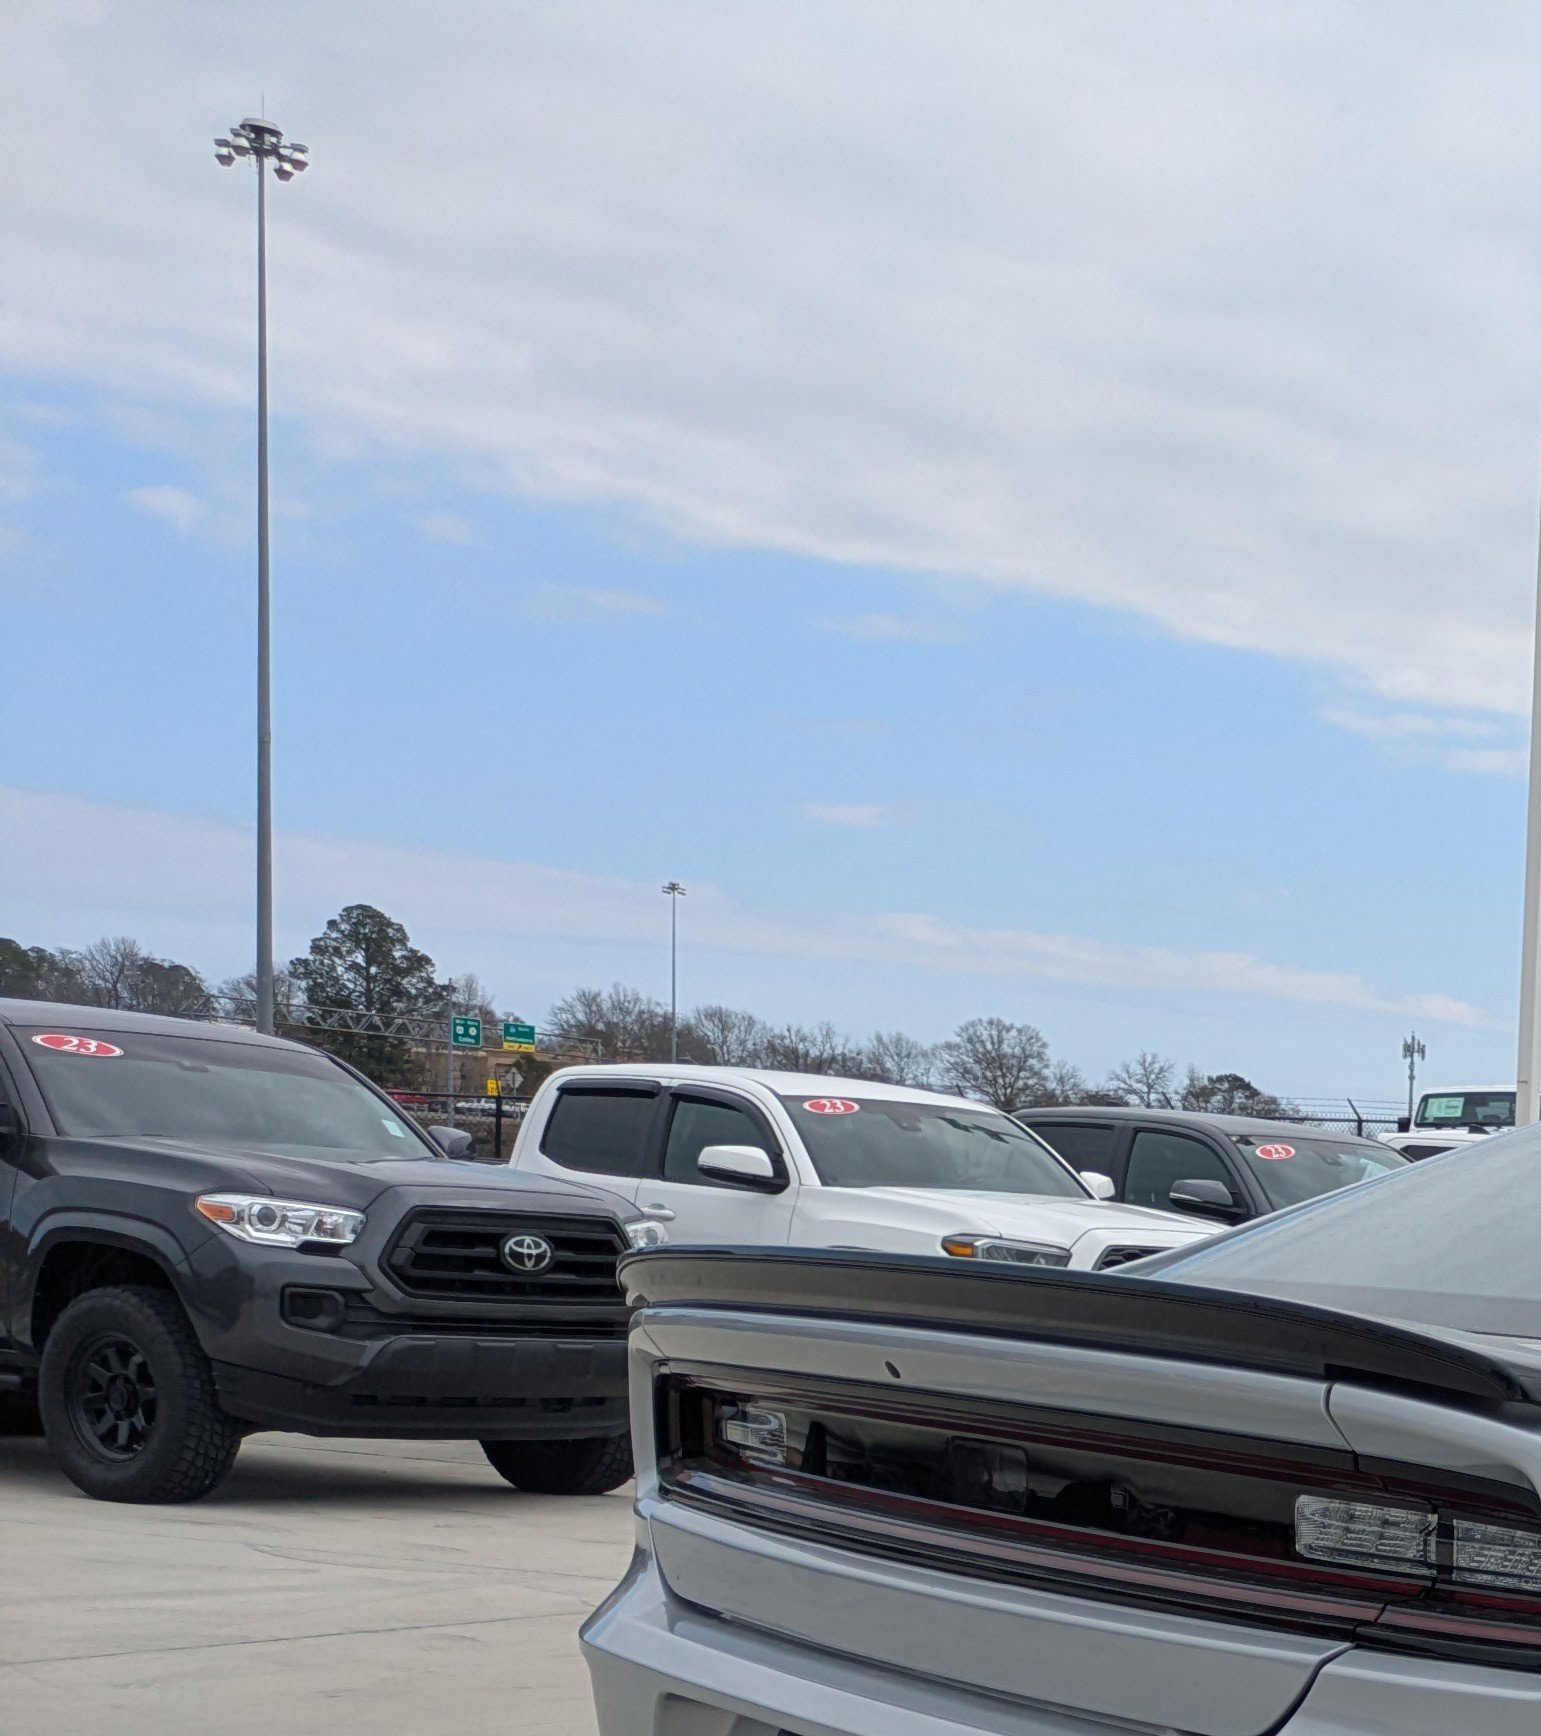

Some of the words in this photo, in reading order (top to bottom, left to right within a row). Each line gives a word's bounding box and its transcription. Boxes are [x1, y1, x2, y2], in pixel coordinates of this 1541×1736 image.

[62, 1037, 98, 1053] 23
[820, 1099, 845, 1113] 23
[1266, 1145, 1286, 1158] 23
